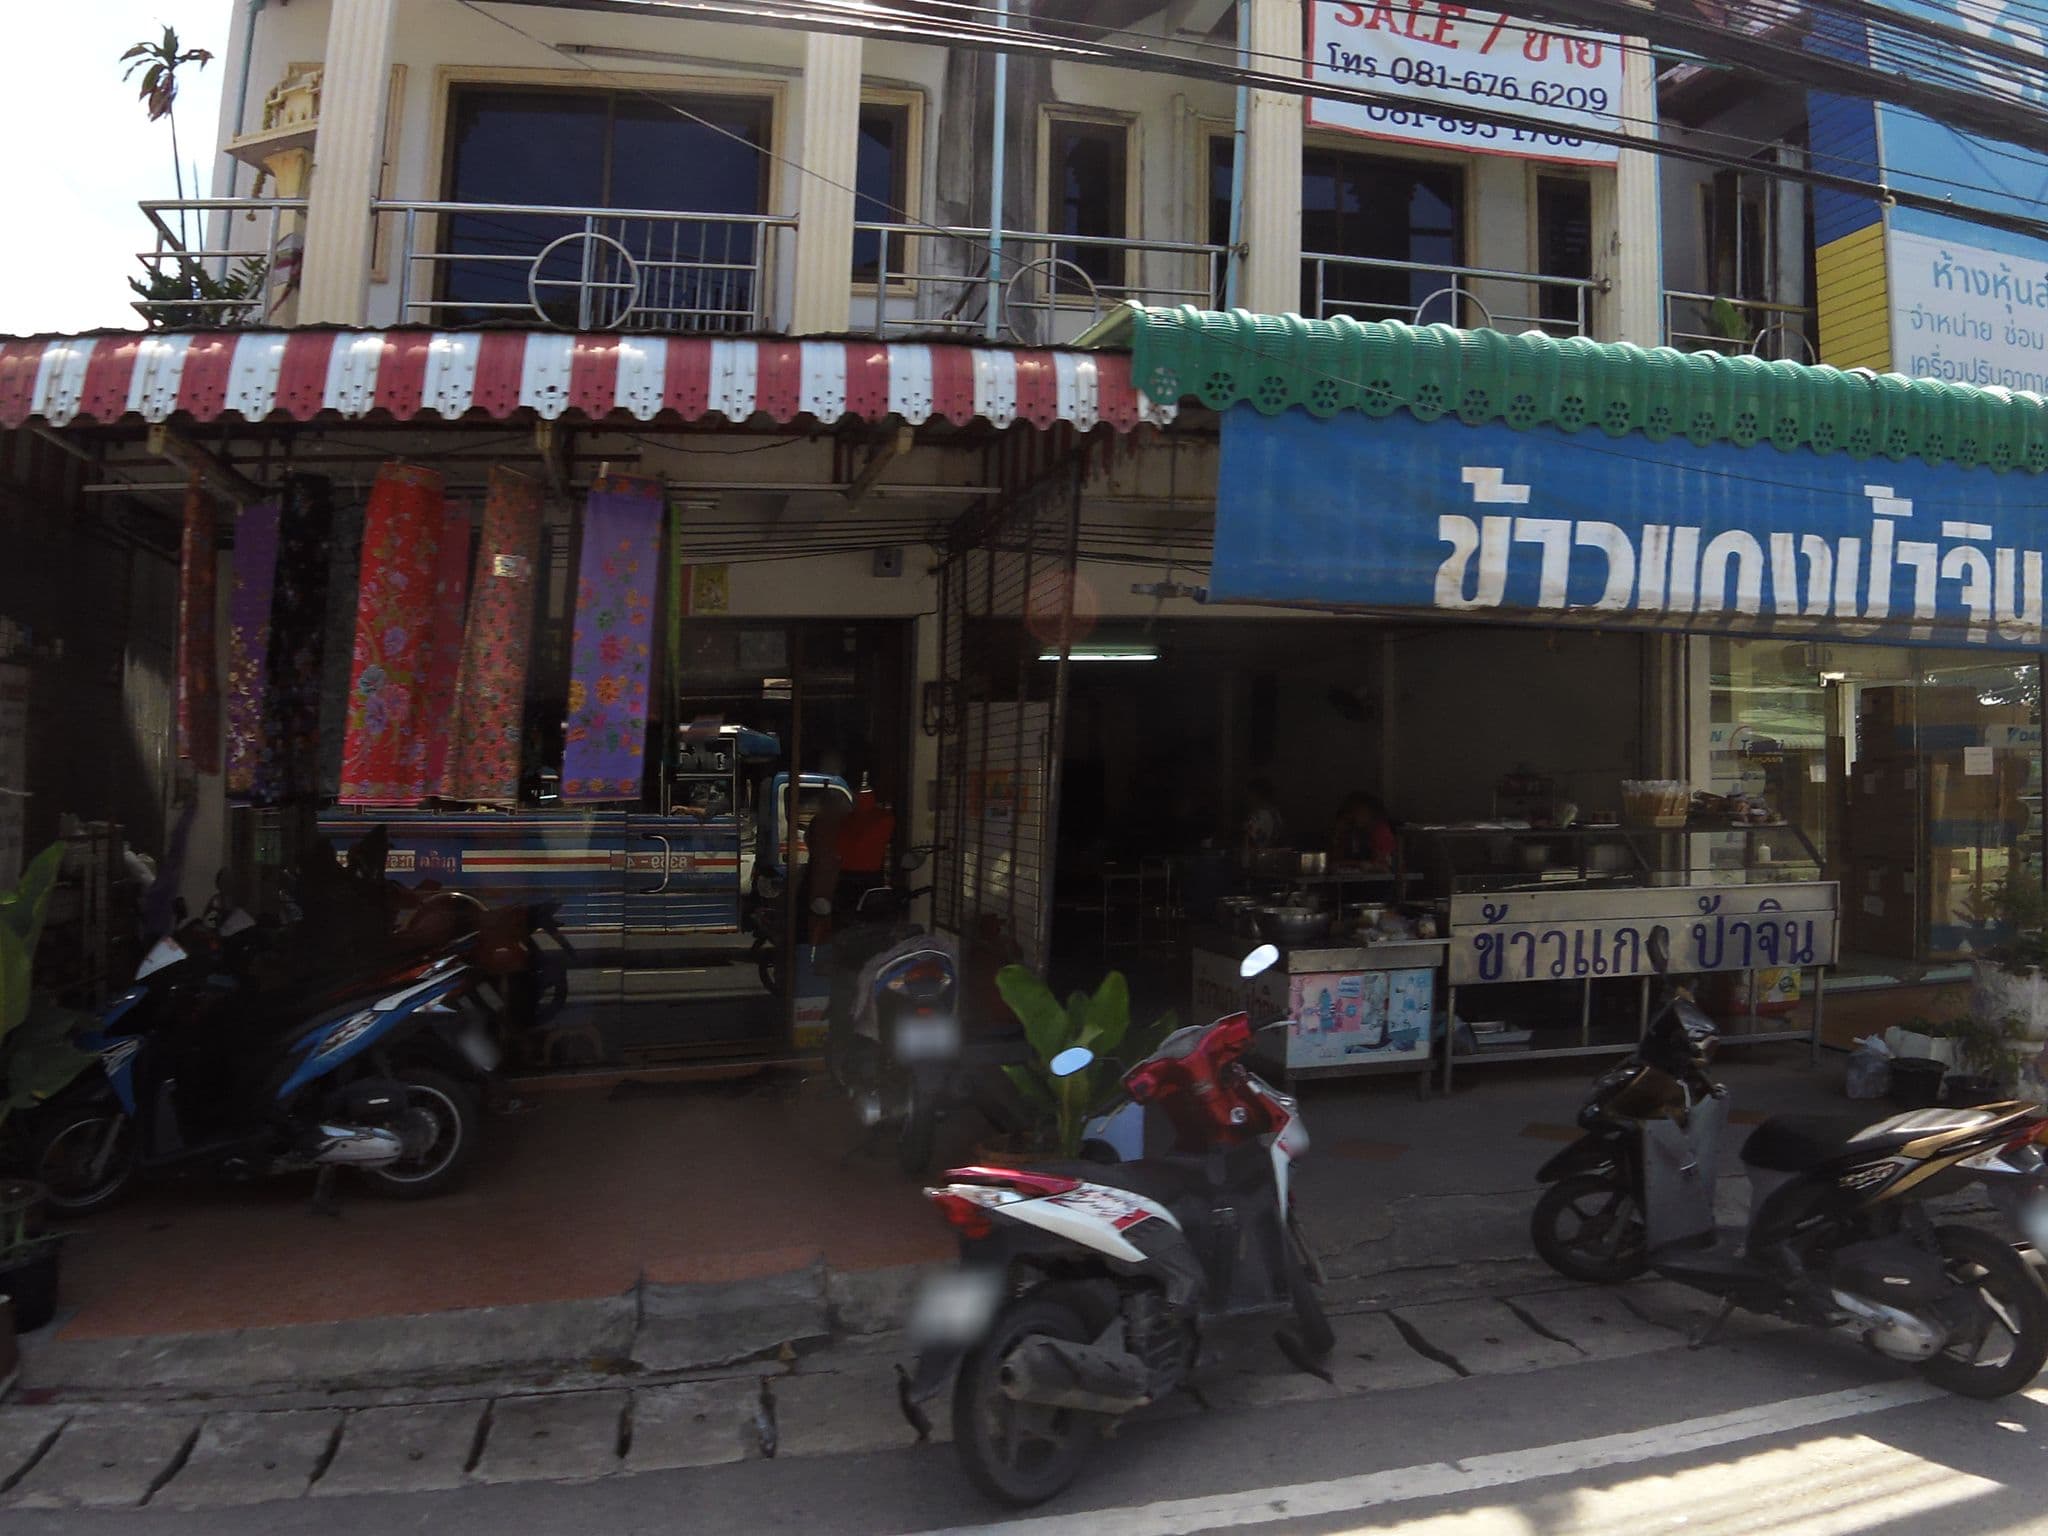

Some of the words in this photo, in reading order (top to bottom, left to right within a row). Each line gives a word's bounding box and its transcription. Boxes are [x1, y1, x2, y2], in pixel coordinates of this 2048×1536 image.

[1335, 0, 1466, 49] SALE
[1523, 27, 1602, 69] ขาย
[1327, 42, 1378, 78] โทร
[1391, 57, 1518, 100] 081-676
[1531, 80, 1608, 112] 6209
[1910, 302, 1992, 342] จำหน่าย
[1911, 344, 2048, 393] เครื่องปรับอากา
[1473, 903, 1668, 981] ข้าวแก
